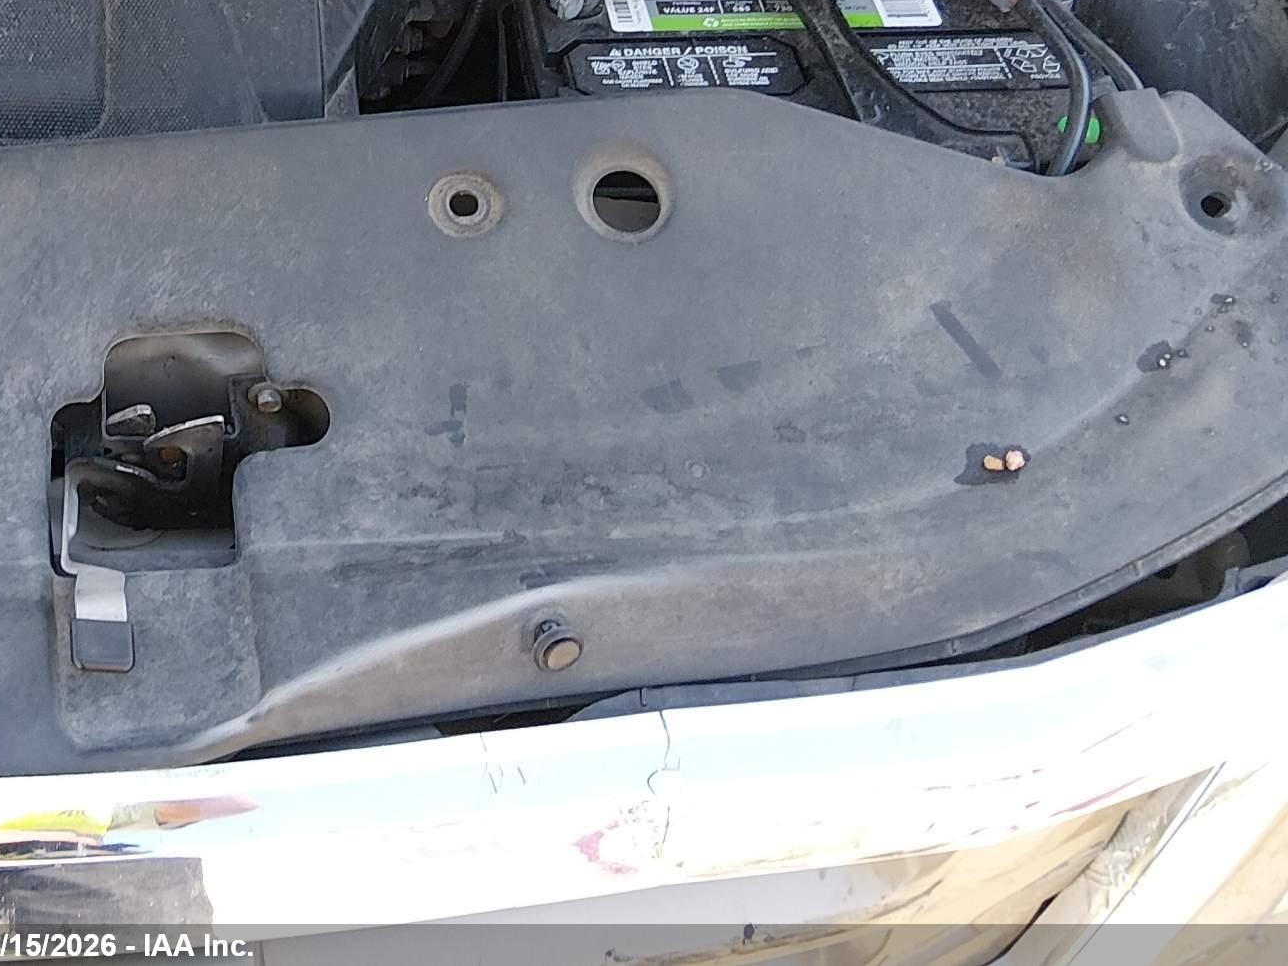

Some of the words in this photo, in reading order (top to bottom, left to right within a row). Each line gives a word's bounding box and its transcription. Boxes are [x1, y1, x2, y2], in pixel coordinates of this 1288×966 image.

[662, 6, 697, 14] VALUE
[623, 47, 681, 57] DANGER
[694, 45, 749, 55] POISON
